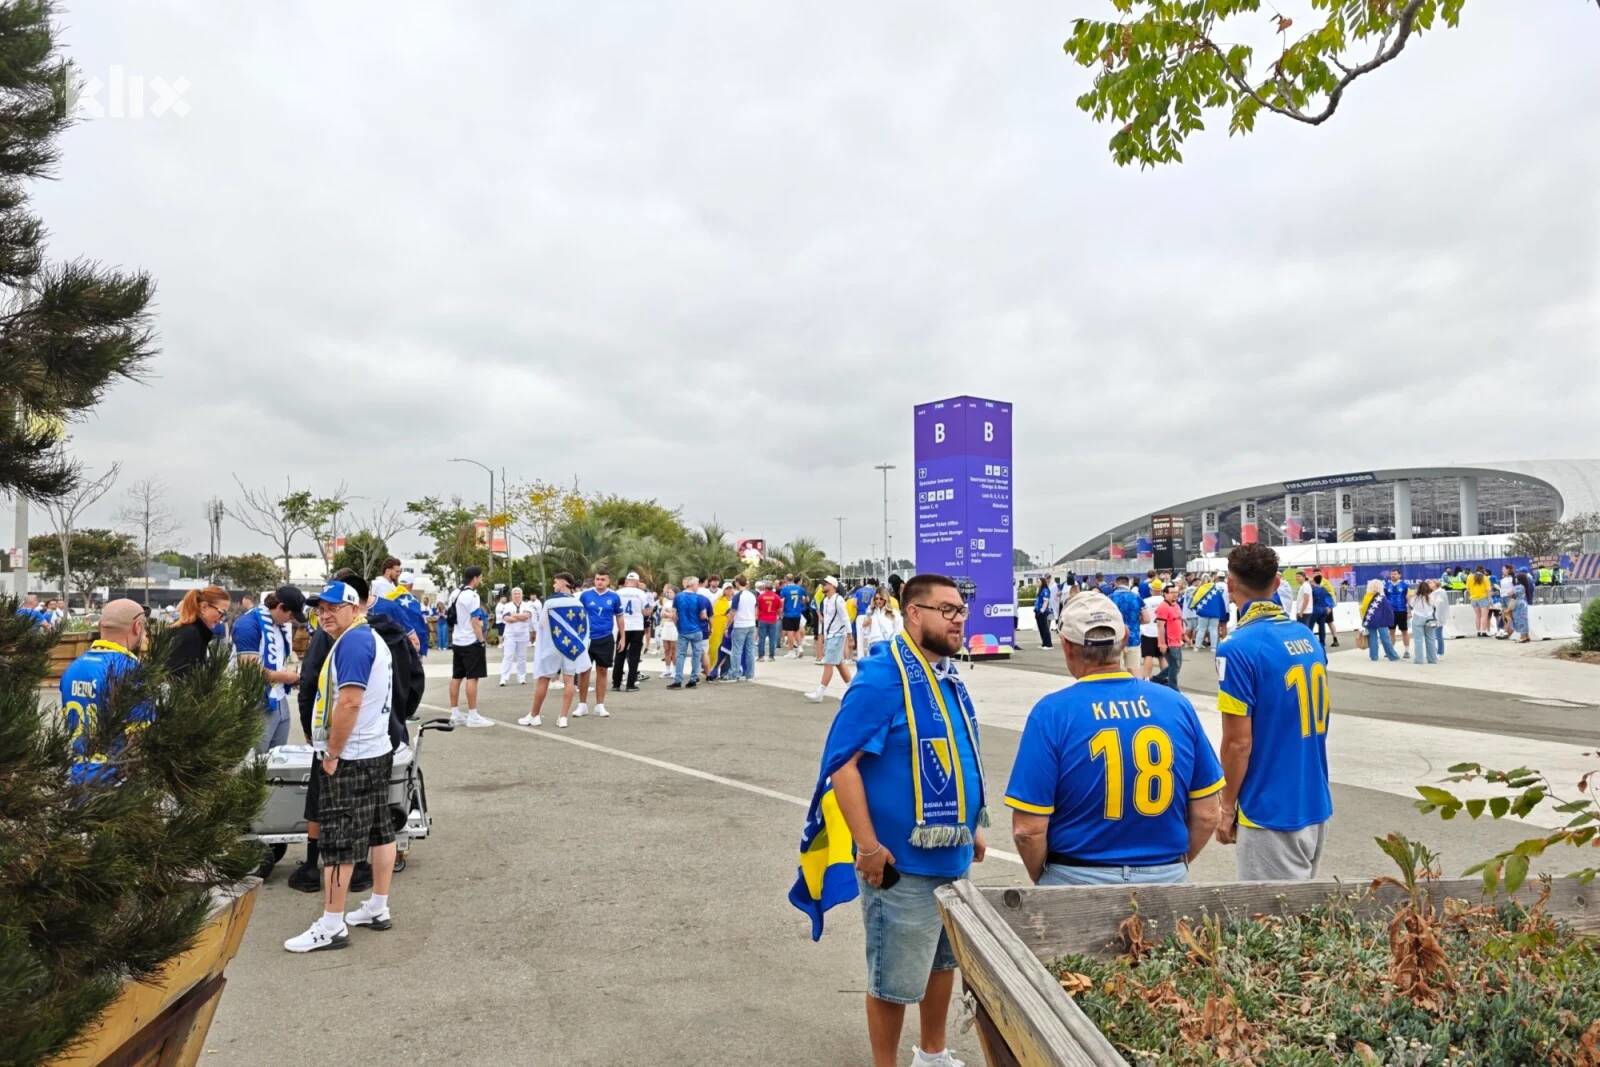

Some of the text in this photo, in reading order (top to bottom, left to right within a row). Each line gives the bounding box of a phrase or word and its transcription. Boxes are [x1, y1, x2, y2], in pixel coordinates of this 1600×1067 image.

[935, 422, 946, 444] B
[984, 421, 994, 442] B
[1302, 479, 1329, 488] WORLD
[1344, 474, 1373, 482] 2026
[625, 600, 633, 615] 4
[1284, 639, 1314, 656] ELVIS
[1092, 696, 1151, 720] KATIĆ
[1284, 661, 1330, 739] 10
[1088, 725, 1174, 820] 18
